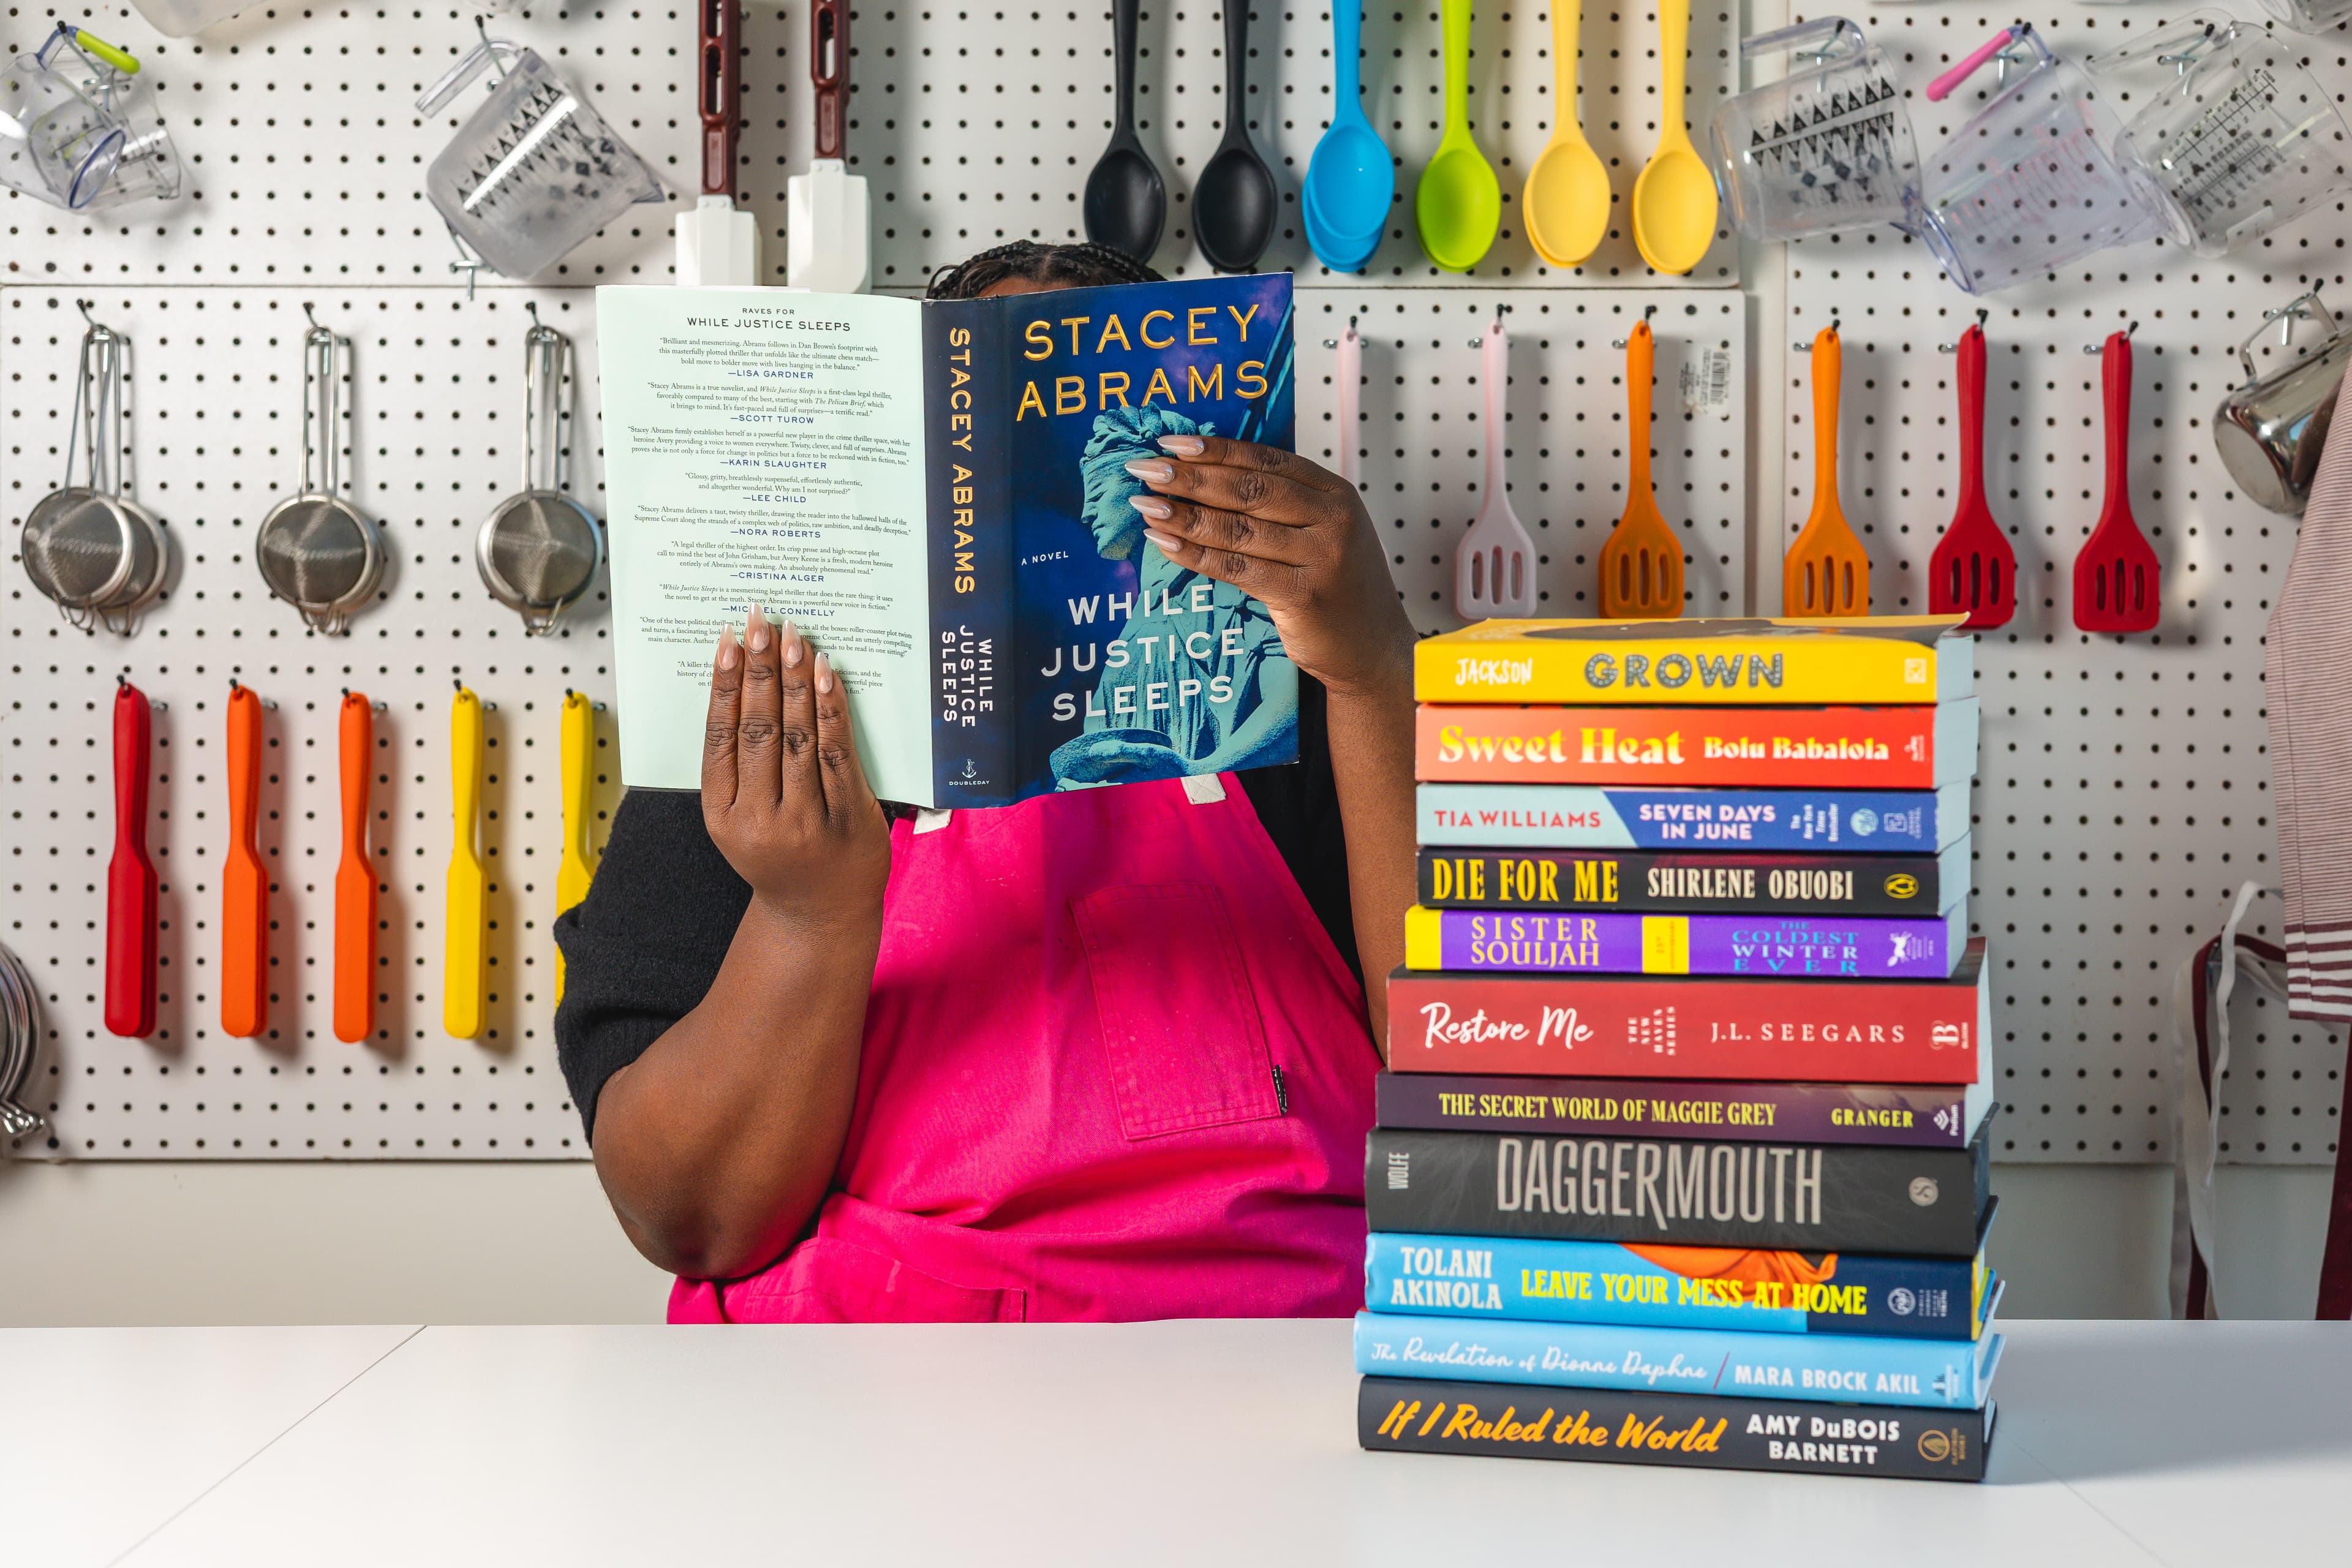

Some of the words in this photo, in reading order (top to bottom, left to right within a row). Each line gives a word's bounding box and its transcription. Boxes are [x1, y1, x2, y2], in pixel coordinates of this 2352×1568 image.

[687, 317, 729, 326] WHILE
[734, 319, 793, 329] JUSTICE
[798, 321, 850, 331] SLEEPS
[1023, 303, 1261, 361] STACEY
[763, 370, 813, 379] GARDNER
[789, 361, 813, 370] hanging
[949, 327, 972, 453] STACEY
[1017, 360, 1268, 422] ABRAMS
[764, 460, 827, 469] SLAUGHTER
[710, 483, 741, 491] altogether
[774, 484, 790, 494] Why
[772, 529, 821, 538] ROBERTS
[952, 464, 976, 594] ABRAMS
[753, 563, 777, 571] making.
[789, 564, 819, 573] absolutely
[1021, 557, 1028, 566] A
[1033, 551, 1069, 565] NOVEL
[722, 605, 776, 614] —MICEL
[780, 608, 835, 616] CONNELLY
[1068, 583, 1215, 625] WHILE
[1041, 628, 1245, 677] JUSTICE
[941, 631, 957, 722] SLEEPS
[960, 625, 976, 728] JUSTICE
[978, 638, 994, 712] WHILE
[1455, 658, 1533, 687] JACKSON
[1584, 653, 1784, 689] GROWN
[1052, 675, 1234, 722] SLEEPS
[1438, 725, 1567, 763] Sweet
[1578, 728, 1686, 765] Heat
[1703, 737, 1765, 760] Bolu
[1772, 738, 1890, 760] Babalola
[1434, 810, 1476, 827] TIA
[1479, 810, 1602, 829] WILLIAMS
[1639, 804, 1716, 823] SEVEN
[1718, 804, 1776, 823] DAYS
[1790, 815, 1801, 829] The
[1803, 804, 1814, 822] York
[1815, 810, 1826, 833] Times
[1828, 803, 1839, 843] Bestseller
[1661, 823, 1689, 840] IN
[1693, 823, 1752, 841] JUNE
[1803, 822, 1814, 840] New
[1432, 859, 1487, 902] DIE
[1499, 859, 1561, 903] FOR
[1574, 860, 1619, 903] ME
[1647, 868, 1757, 899] SHIRLENE
[1768, 869, 1855, 900] OBUOBI
[1471, 917, 1598, 941] SISTER
[1732, 930, 1859, 945] COLDEST
[1780, 921, 1810, 930] THE
[1471, 941, 1600, 967] SOULJAH
[1732, 944, 1858, 959] WINTER
[1733, 959, 1857, 973] EVER
[1421, 1002, 1530, 1048] Restore
[1536, 1006, 1594, 1046] Me
[1627, 1017, 1637, 1044] THE
[1640, 1017, 1651, 1045] NEW
[1653, 1008, 1663, 1054] HAVEN
[1667, 1006, 1676, 1056] SERIES
[1710, 1022, 1751, 1043] J.L.
[1761, 1023, 1905, 1043] SEEGARS
[1438, 1093, 1476, 1118] THE
[1478, 1094, 1549, 1120] SECRET
[1551, 1096, 1616, 1121] WORLD
[1619, 1099, 1647, 1123] OF
[1650, 1099, 1724, 1125] MAGGIE
[1727, 1102, 1777, 1127] GREY
[1831, 1107, 1915, 1129] GRANGER
[1950, 1104, 1959, 1136] Podium
[1387, 1151, 1410, 1191] WOLFE
[1497, 1137, 1823, 1231] DAGGERMOUTH
[1400, 1247, 1491, 1276] TOLANI
[1390, 1278, 1503, 1311] AKINOLA
[1520, 1269, 1593, 1303] LEAVE
[1601, 1273, 1669, 1305] YOUR
[1677, 1277, 1745, 1309] MESS
[1752, 1280, 1784, 1311] AT
[1792, 1284, 1868, 1316] HOME
[1373, 1342, 1396, 1363] The
[1403, 1338, 1512, 1372] Revelation
[1519, 1355, 1536, 1373] of
[1542, 1345, 1618, 1377] Dionne
[1622, 1352, 1707, 1382] Daphne
[1734, 1365, 1798, 1387] MARA
[1802, 1368, 1871, 1391] BROCK
[1875, 1372, 1920, 1394] AKIL
[1378, 1400, 1420, 1438] If
[1420, 1402, 1443, 1439] I
[1442, 1405, 1555, 1446] Ruled
[1553, 1413, 1610, 1447] the
[1616, 1413, 1727, 1454] World
[1746, 1414, 1801, 1437] AMY
[1811, 1416, 1901, 1441] DuBOIS
[1768, 1441, 1879, 1465] BARNETT
